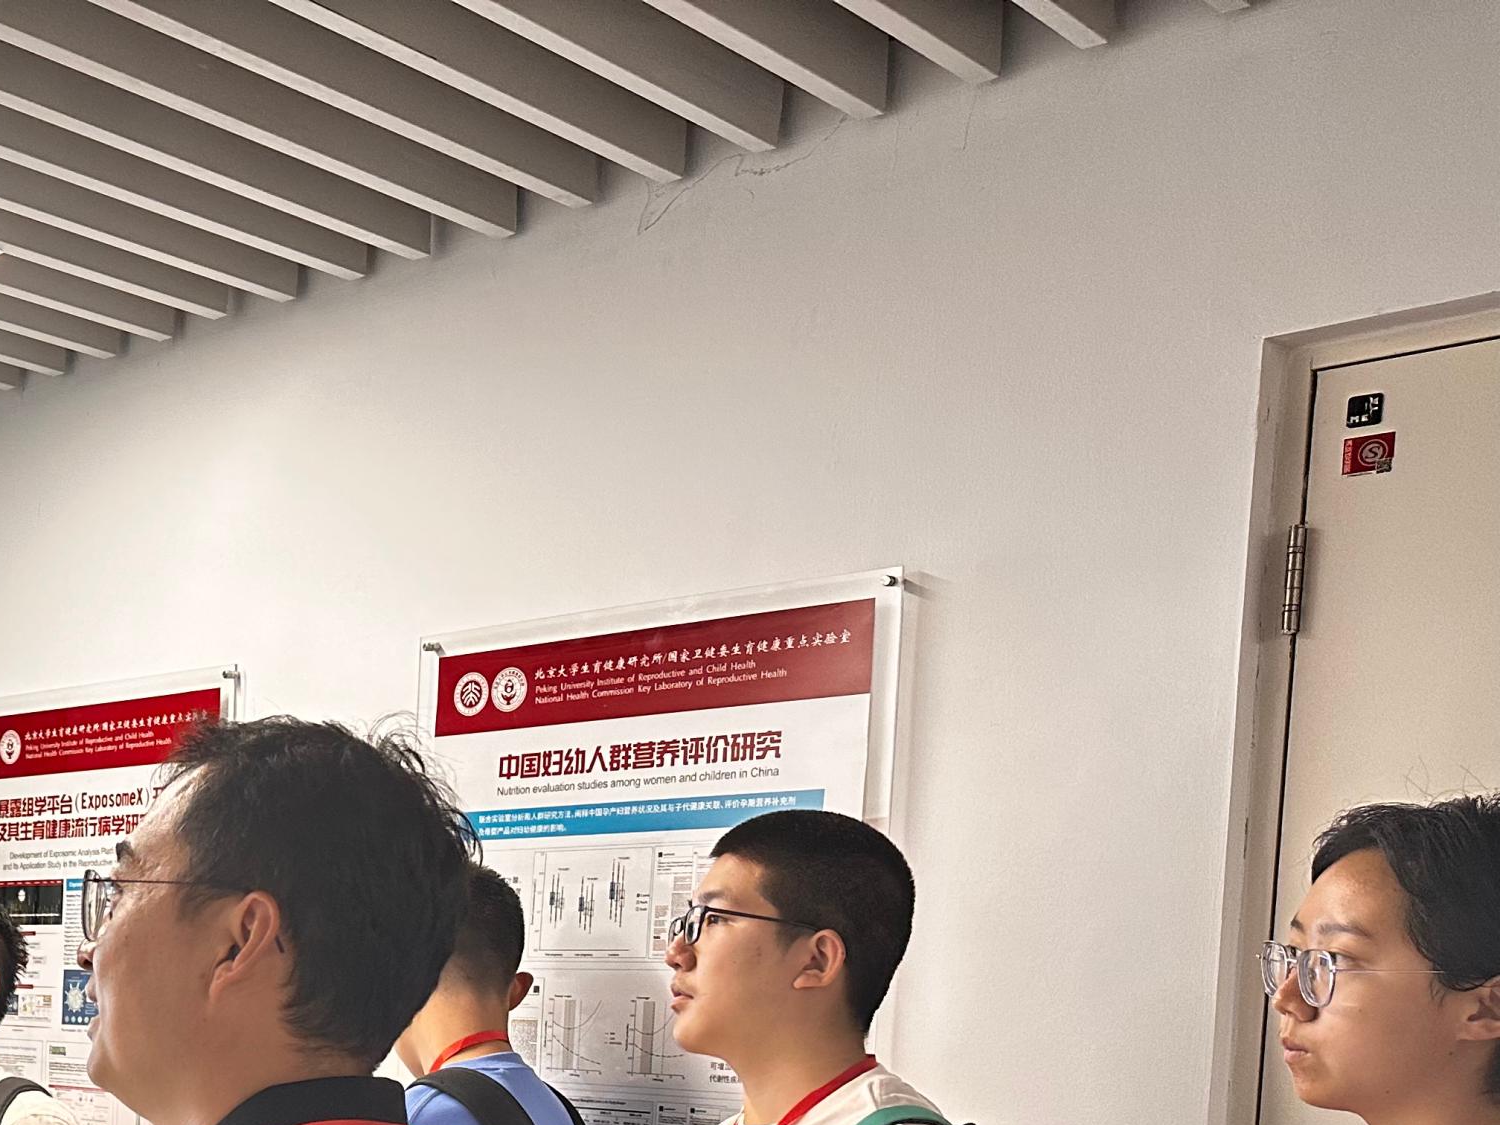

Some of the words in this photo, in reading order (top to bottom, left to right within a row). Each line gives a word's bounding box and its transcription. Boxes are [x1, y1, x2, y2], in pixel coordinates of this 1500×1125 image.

[534, 694, 564, 705] National
[566, 691, 590, 702] Health
[591, 686, 634, 699] Commission
[637, 683, 652, 694] Key
[654, 679, 693, 691] Laboratory
[695, 677, 704, 686] of
[707, 673, 758, 686] Reproductive
[760, 668, 788, 679] Health
[535, 684, 558, 695] Peking
[561, 680, 595, 691] University
[597, 676, 623, 686] Institute
[627, 674, 636, 683] of
[638, 668, 686, 682] Reproductive
[688, 665, 703, 675] and
[706, 661, 727, 673] Child
[730, 659, 756, 671] Health
[498, 730, 782, 779] 中国妇幼人群营养评价研究
[497, 785, 531, 796] Nutrition
[532, 782, 575, 793] evaluation
[577, 779, 608, 790] studies
[610, 777, 641, 789] among
[643, 775, 677, 785] women
[679, 772, 697, 782] and
[699, 769, 737, 781] children
[739, 768, 747, 778] in
[750, 767, 780, 778] China
